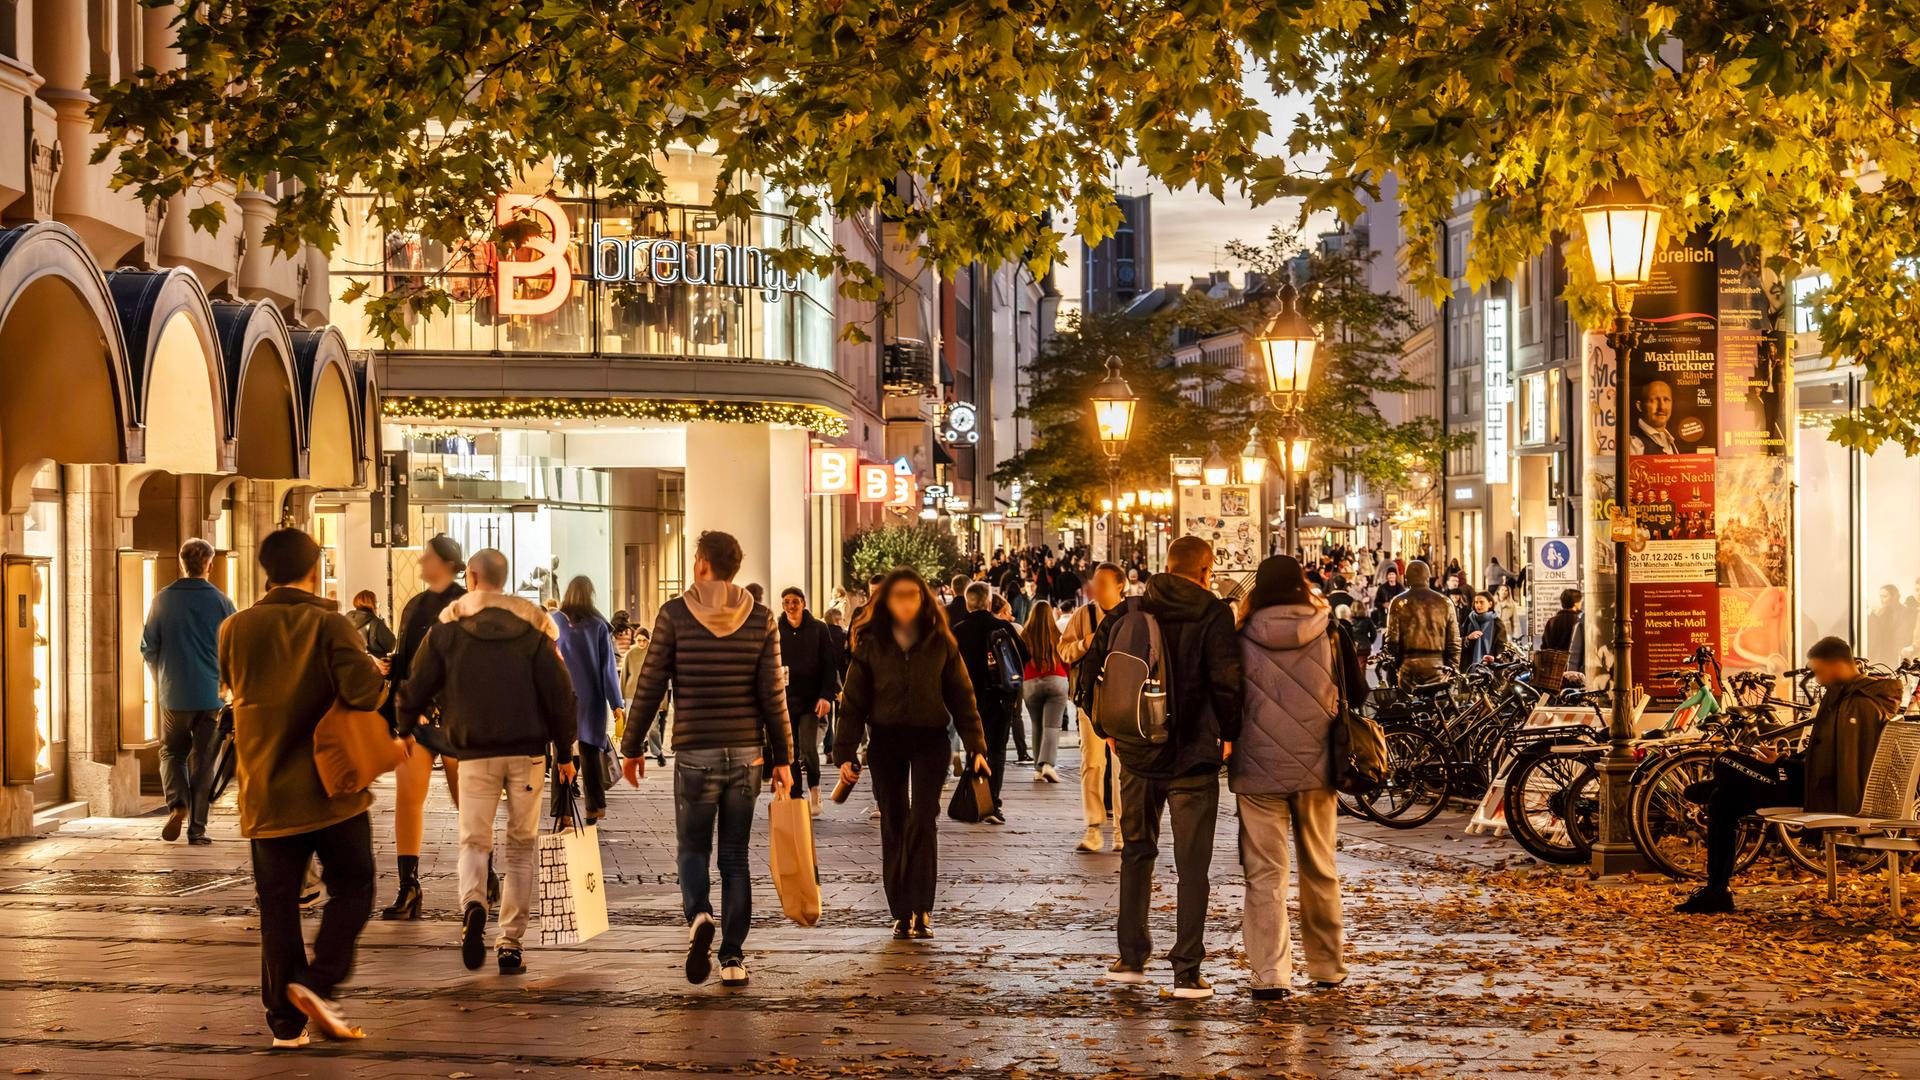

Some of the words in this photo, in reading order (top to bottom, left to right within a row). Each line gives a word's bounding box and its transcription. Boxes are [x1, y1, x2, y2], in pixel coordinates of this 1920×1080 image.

[496, 193, 572, 316] B
[1644, 351, 1715, 362] Maximilian
[1658, 360, 1715, 371] Brückner
[1683, 371, 1713, 379] Räuber
[1697, 397, 1712, 405] Nov.
[821, 453, 846, 489] B
[1681, 472, 1715, 483] Nacht
[866, 469, 887, 499] B
[1640, 552, 1683, 561] 07.12.2025
[1691, 552, 1700, 560] 16
[1545, 571, 1567, 579] ZONE
[1645, 619, 1672, 628] Messe
[1674, 618, 1706, 628] h-Moll
